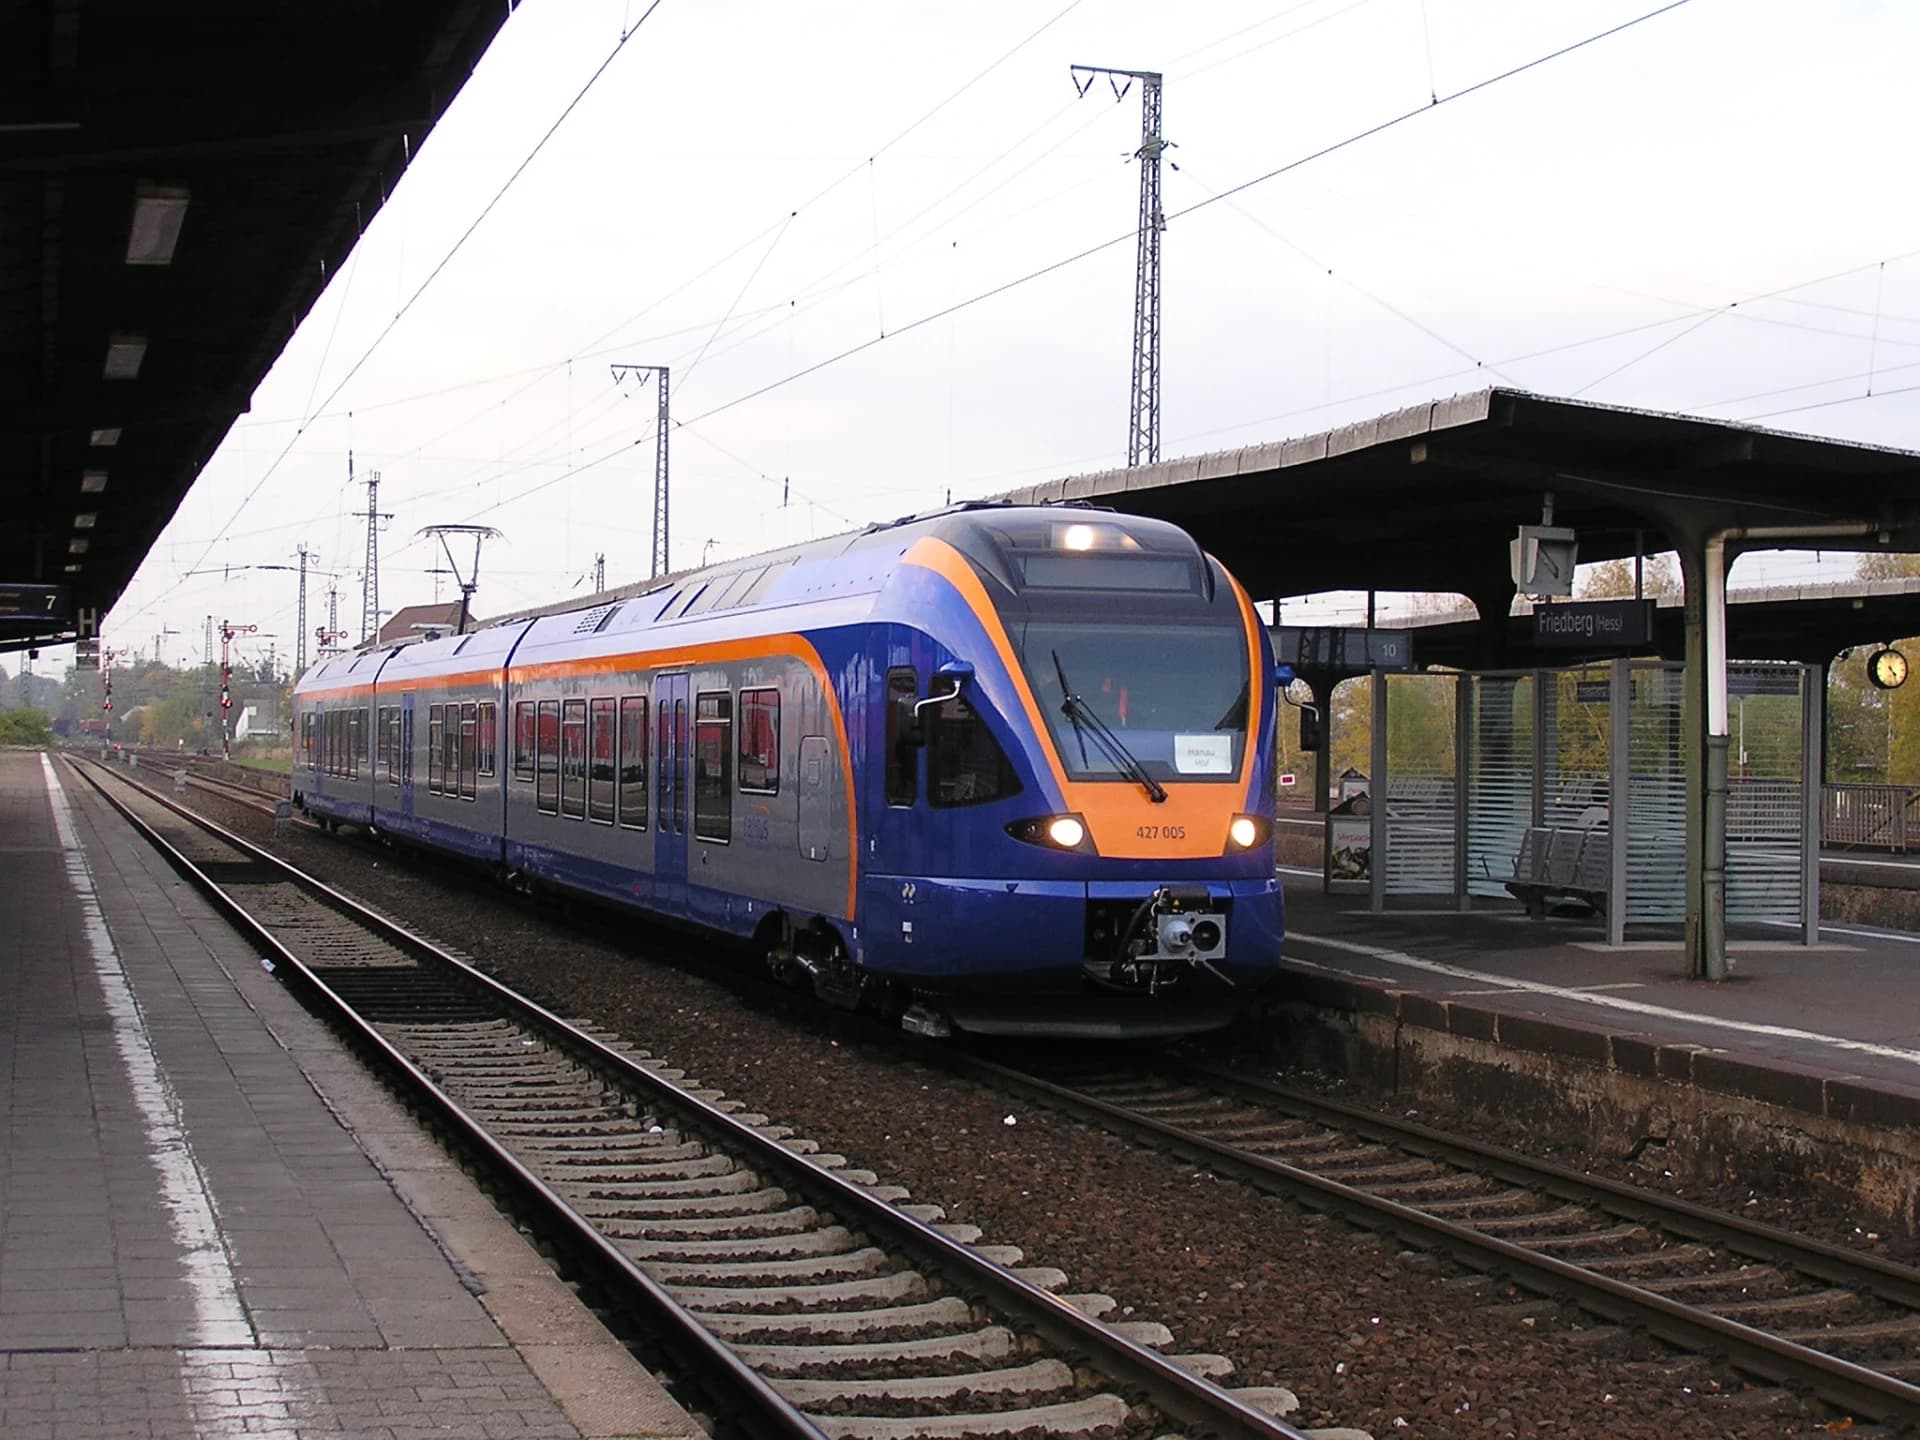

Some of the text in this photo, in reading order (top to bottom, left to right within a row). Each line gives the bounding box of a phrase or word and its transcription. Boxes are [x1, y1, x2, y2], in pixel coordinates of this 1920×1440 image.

[45, 595, 57, 610] 7
[79, 607, 97, 635] H
[1539, 611, 1593, 637] Friedberg
[1382, 643, 1397, 657] 10
[1136, 825, 1186, 839] 427 005
